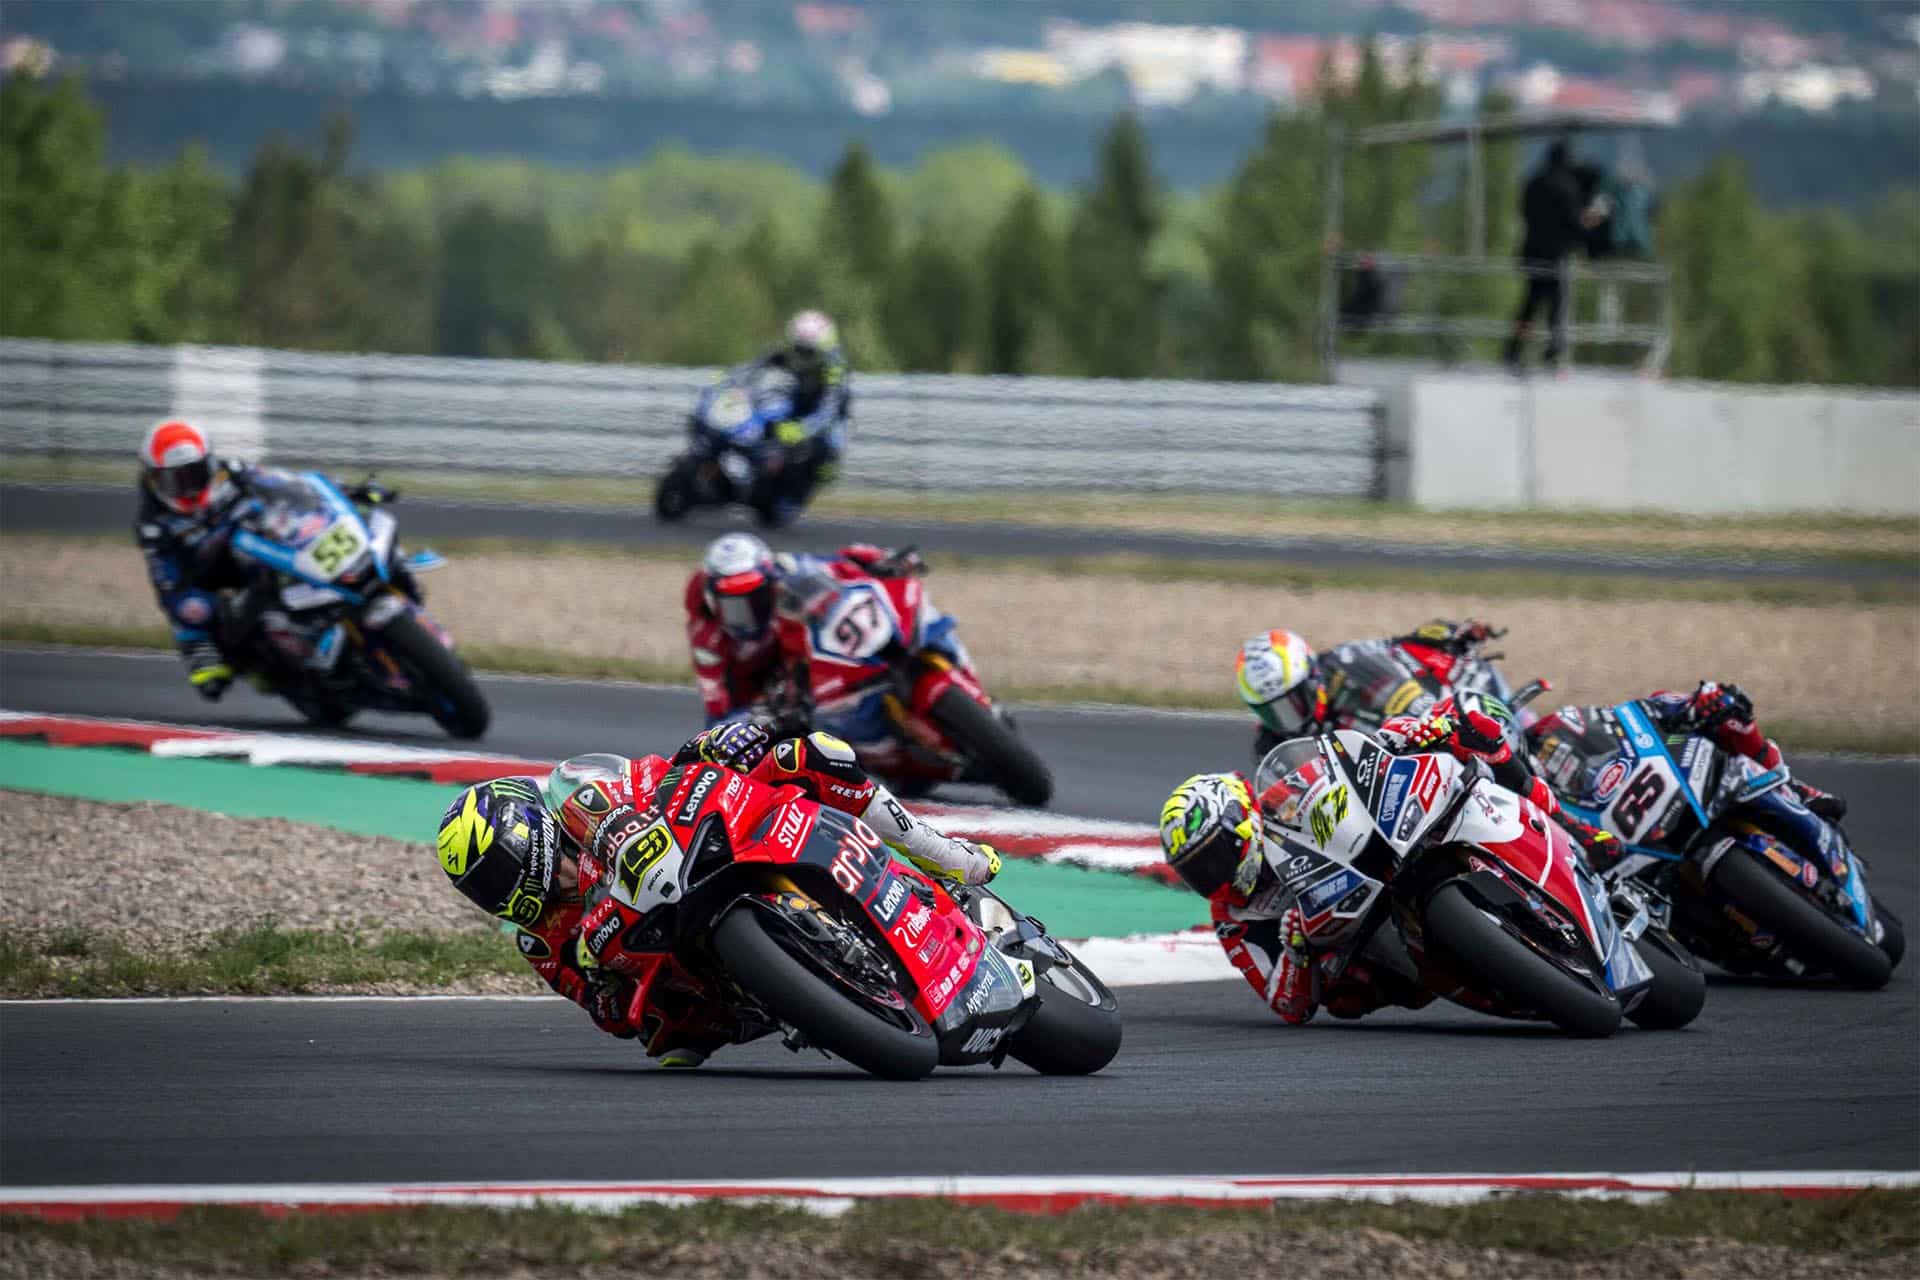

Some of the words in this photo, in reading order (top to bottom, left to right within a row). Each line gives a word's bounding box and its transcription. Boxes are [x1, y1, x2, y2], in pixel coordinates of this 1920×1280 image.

[835, 596, 878, 656] 97
[667, 764, 698, 819] ALTEN
[679, 770, 717, 821] Lenovo
[1611, 763, 1666, 840] 65
[541, 811, 555, 893] SCORPION
[874, 880, 905, 921] Lenovo
[588, 916, 620, 954] Lenovo
